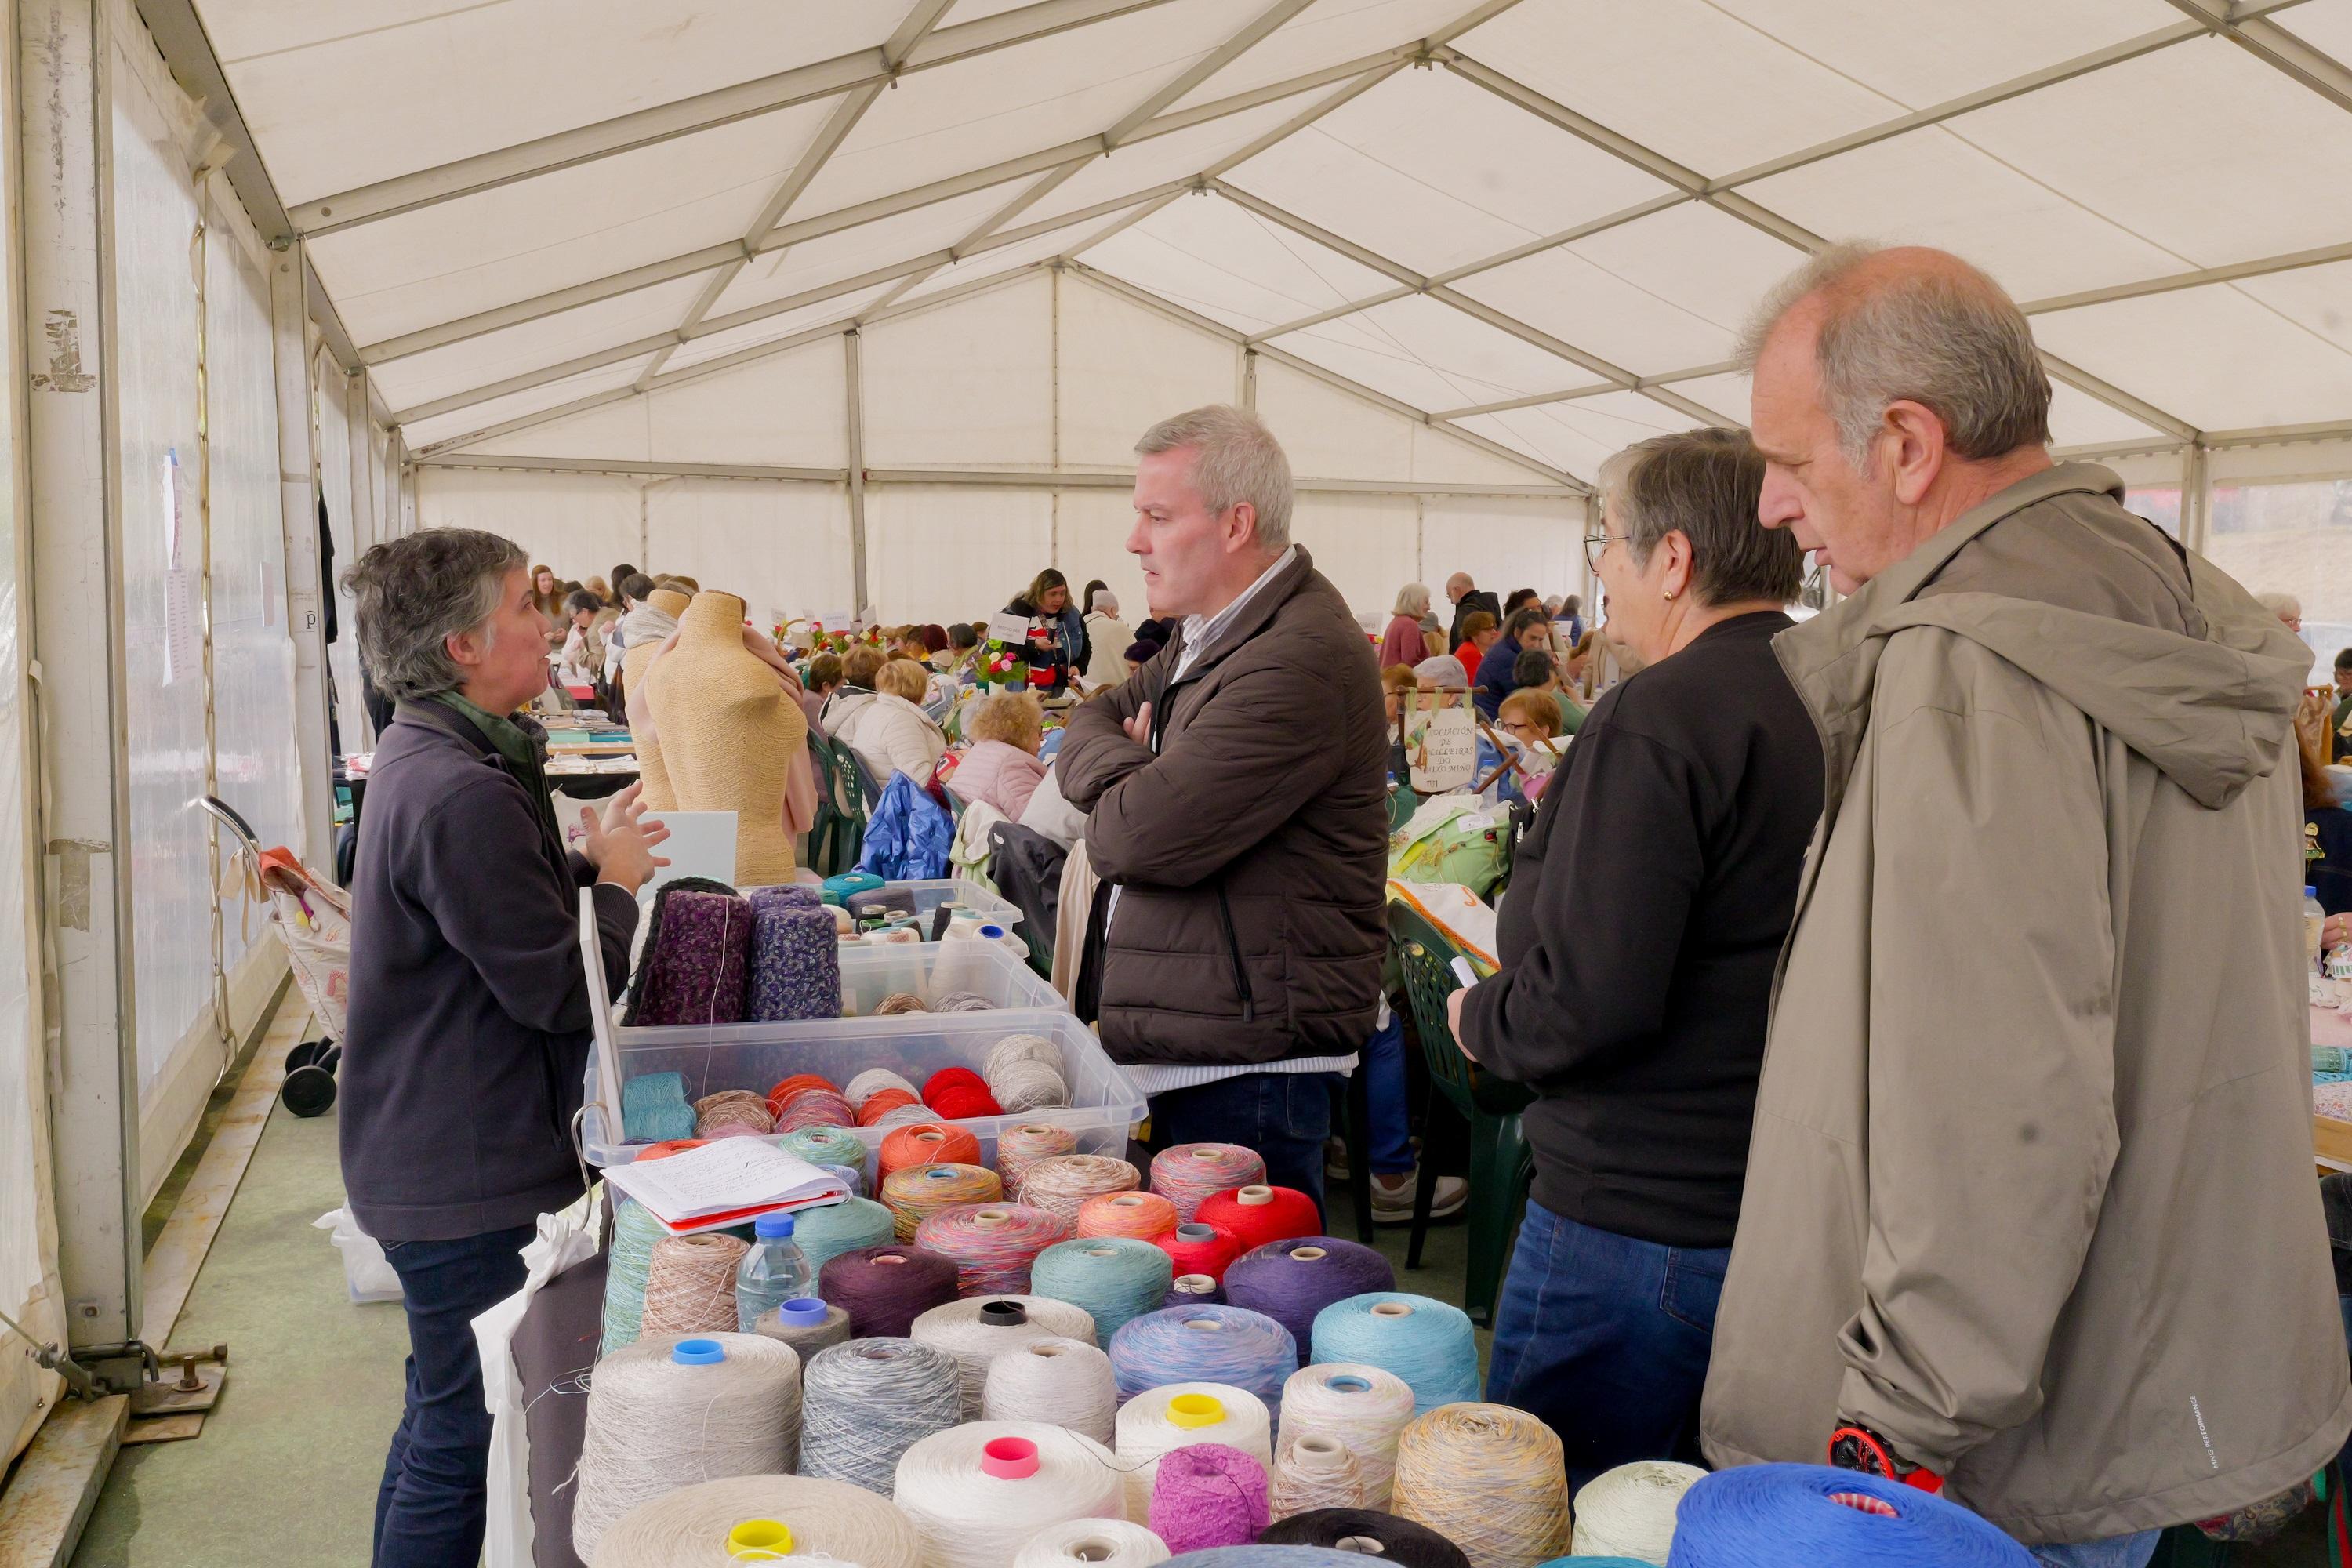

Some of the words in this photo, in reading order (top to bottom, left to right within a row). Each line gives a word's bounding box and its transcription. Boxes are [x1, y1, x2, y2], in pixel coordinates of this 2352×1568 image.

[1428, 764, 1446, 773] IXO
[2190, 1395, 2212, 1448] PERFORMANCE
[2207, 1449, 2219, 1468] MNG
